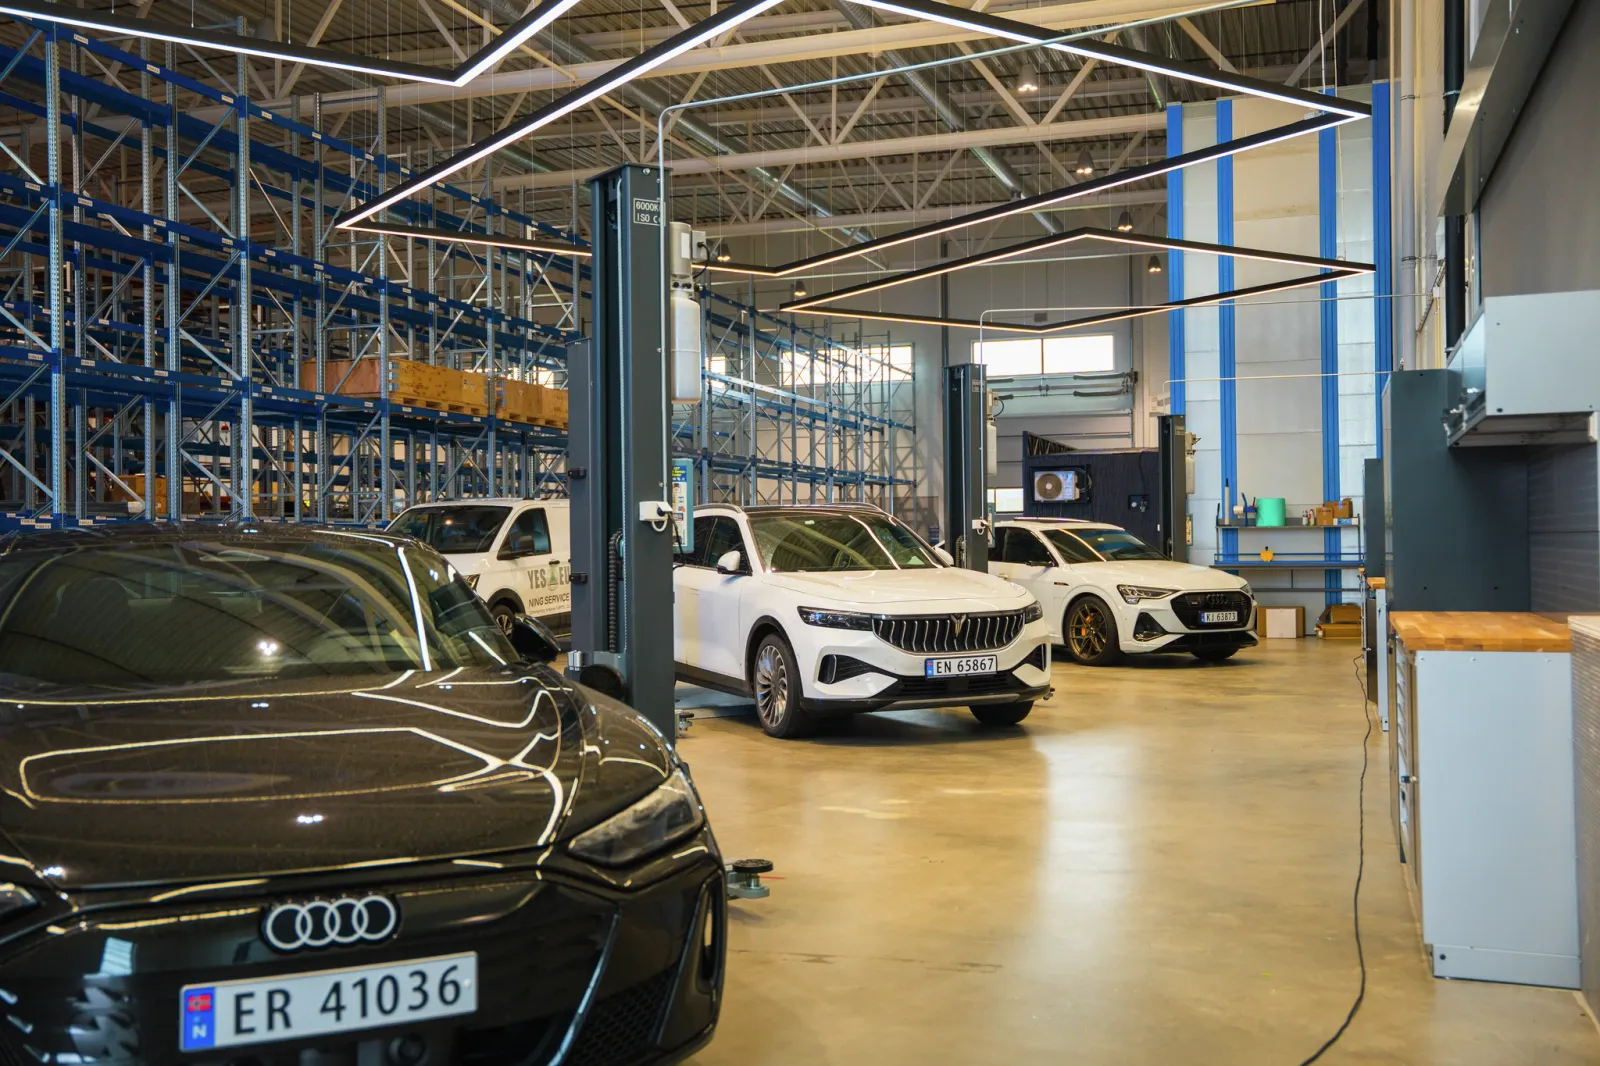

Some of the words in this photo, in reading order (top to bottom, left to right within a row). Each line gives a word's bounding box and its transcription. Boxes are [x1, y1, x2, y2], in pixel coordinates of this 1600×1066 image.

[635, 201, 661, 212] 6000K
[637, 212, 650, 223] ISO
[527, 568, 547, 590] YES
[528, 596, 544, 608] NING
[544, 592, 570, 605] SERVICE
[1216, 612, 1236, 621] 63873
[936, 661, 952, 674] EN
[957, 658, 994, 672] 65867
[233, 988, 292, 1035] ER
[319, 964, 462, 1022] 41036
[192, 1024, 207, 1038] N
